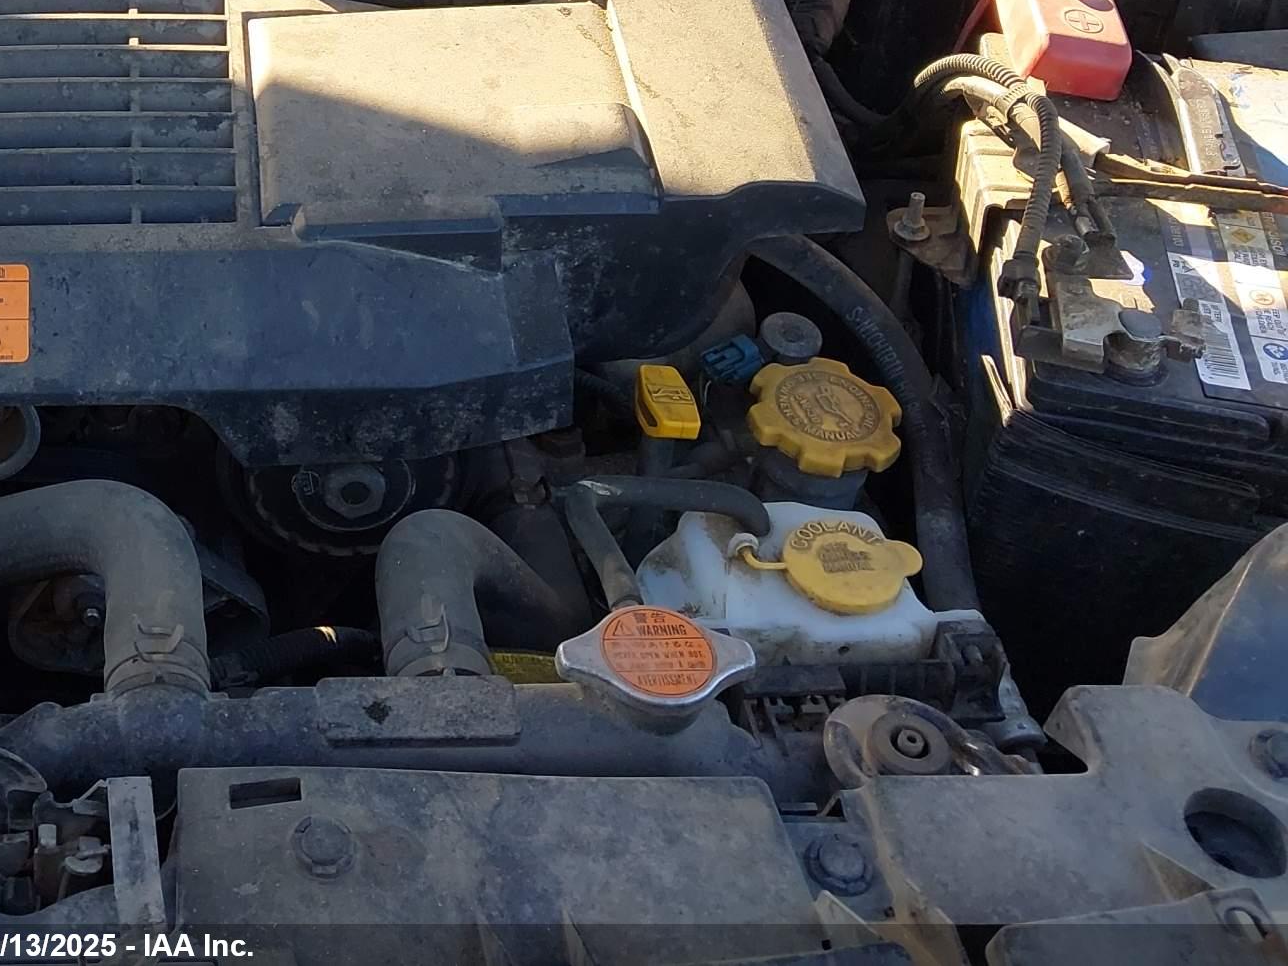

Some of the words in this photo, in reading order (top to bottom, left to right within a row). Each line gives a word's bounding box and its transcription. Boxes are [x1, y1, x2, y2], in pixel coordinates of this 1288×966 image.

[804, 425, 862, 441] MANUAL
[791, 521, 881, 548] COOLANT
[633, 612, 665, 623] 警告
[637, 624, 687, 636] WARNING
